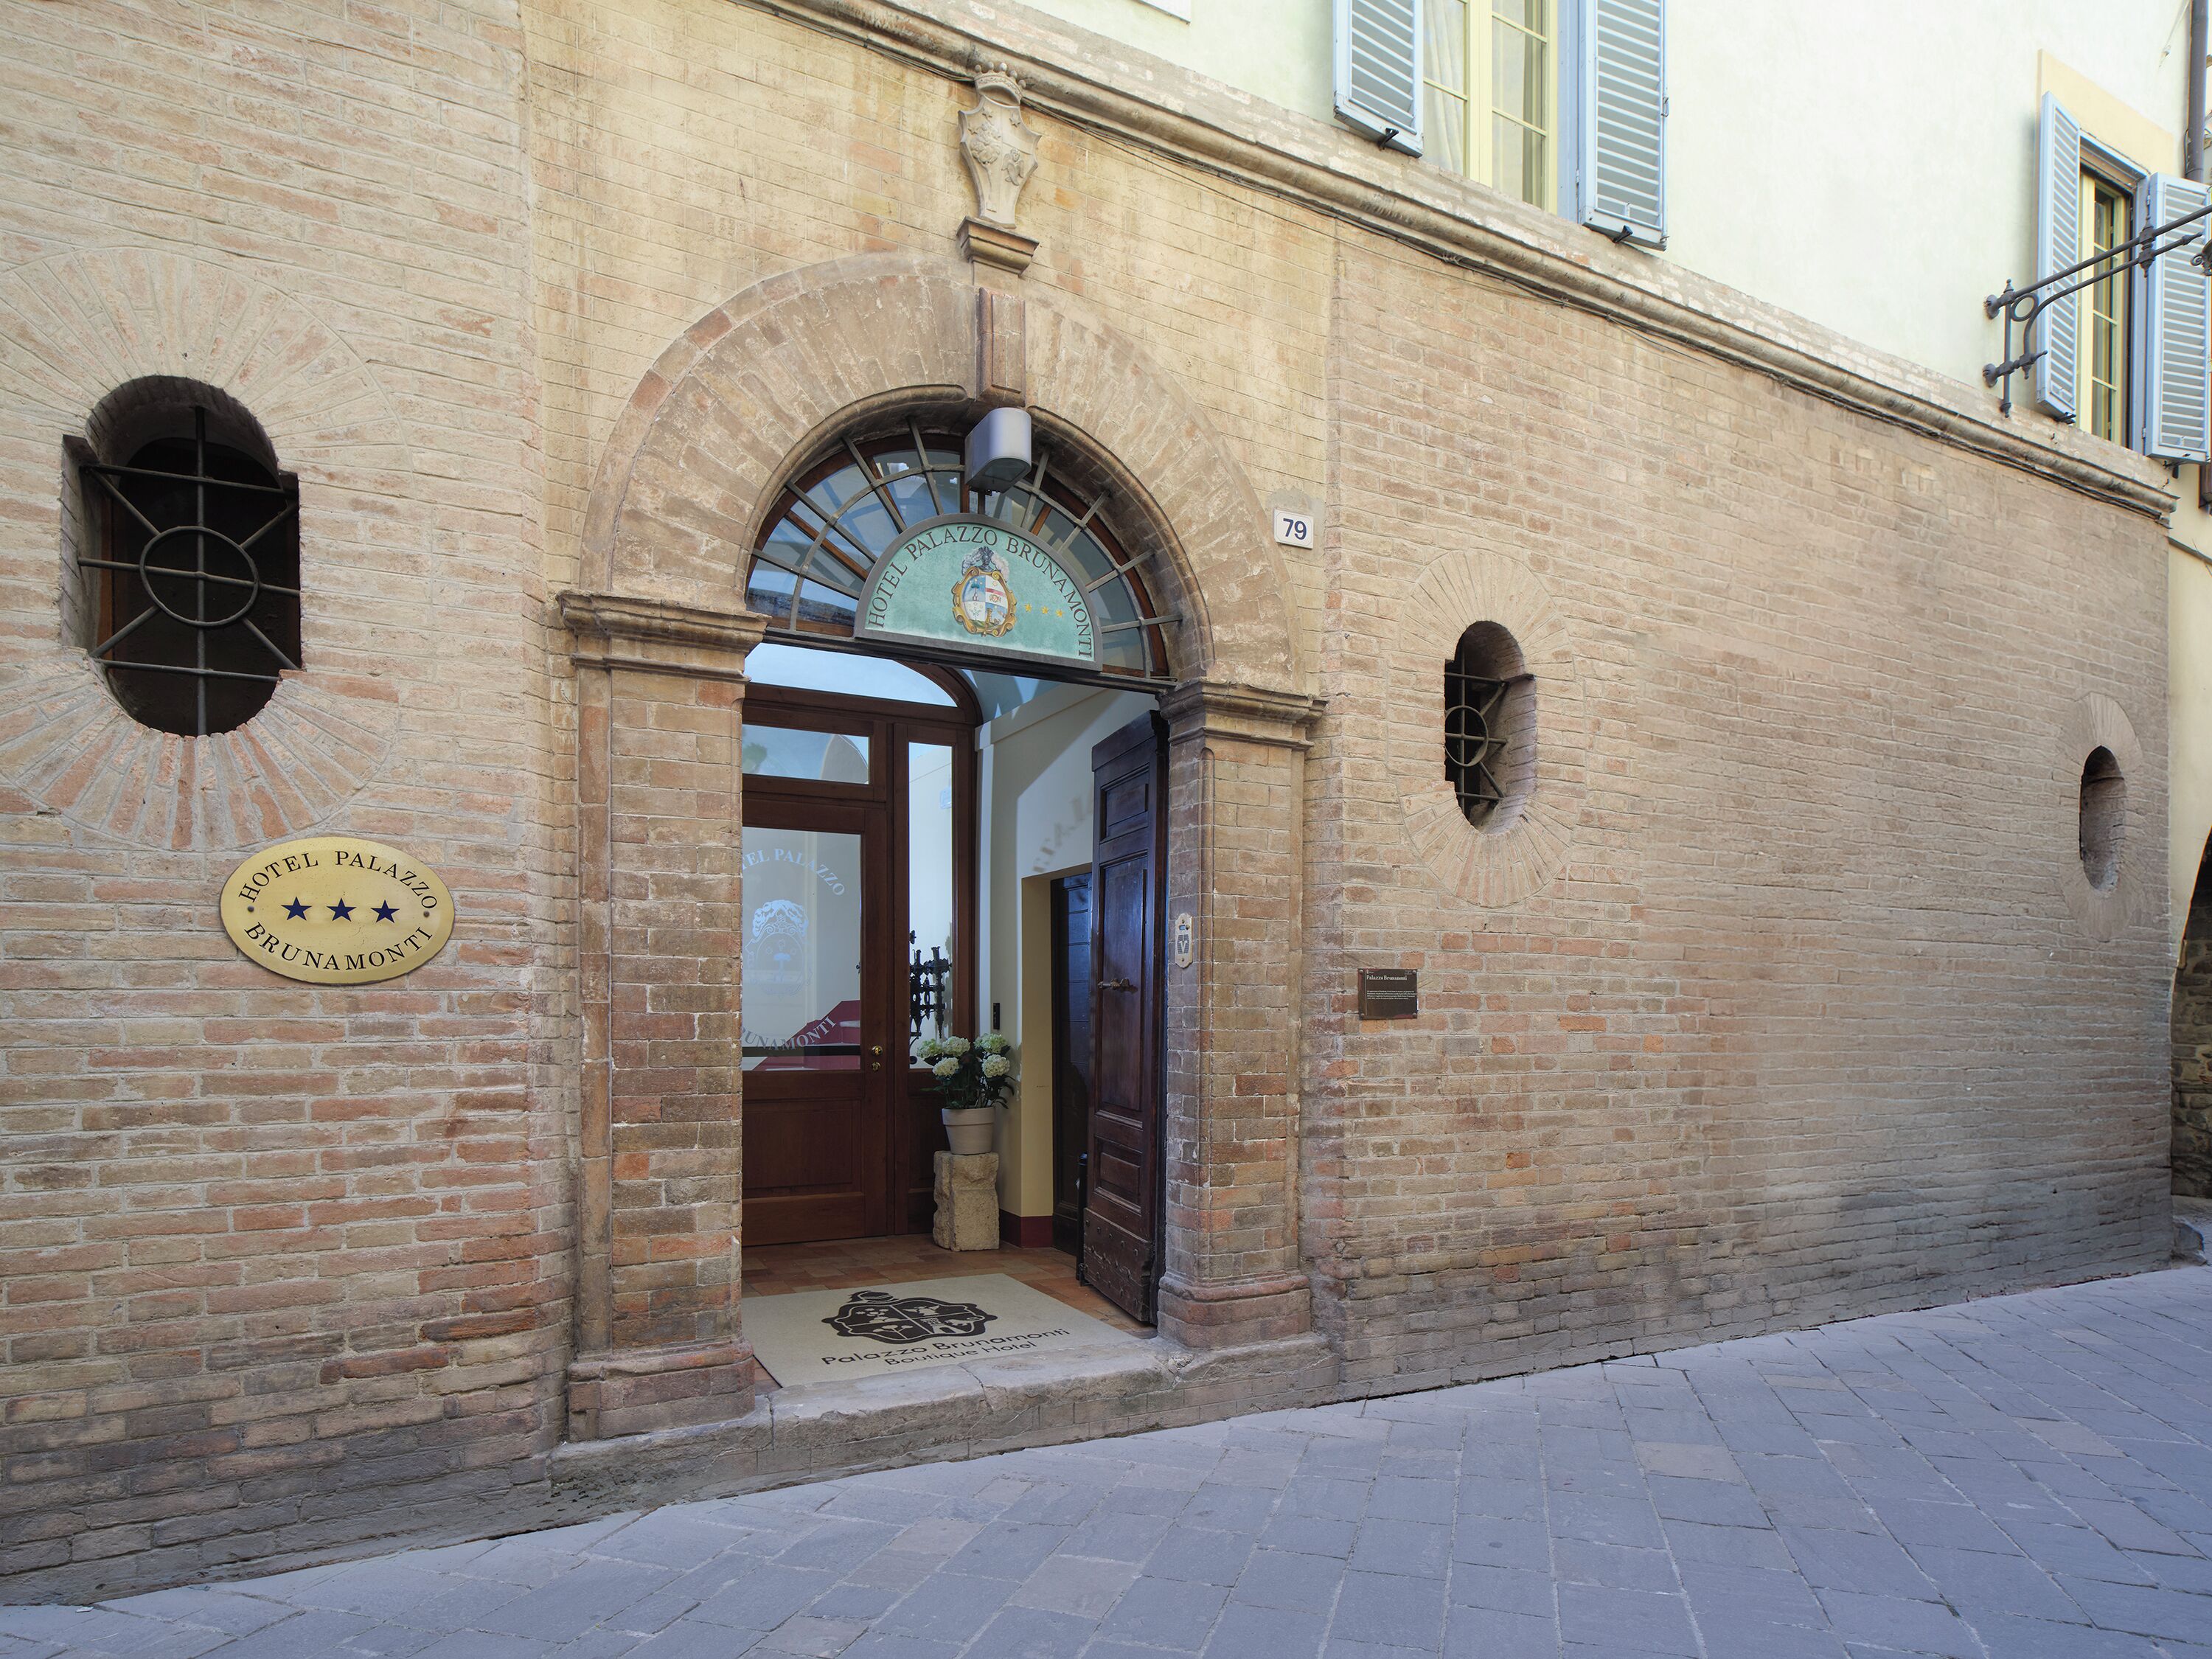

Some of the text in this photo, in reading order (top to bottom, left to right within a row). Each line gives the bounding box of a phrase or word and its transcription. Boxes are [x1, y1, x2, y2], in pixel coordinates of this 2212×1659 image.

[1283, 518, 1307, 540] 79
[869, 526, 1093, 658] HOTEL PALAZZO BRUNAMONTI
[238, 851, 437, 909] HOTEL PALAZZO
[774, 849, 845, 896] PALAZZO
[244, 922, 432, 970] BRUNAMONTI
[821, 1329, 1070, 1365] Palazzo Brunamonti
[884, 1341, 1037, 1366] Boutique Hotel
